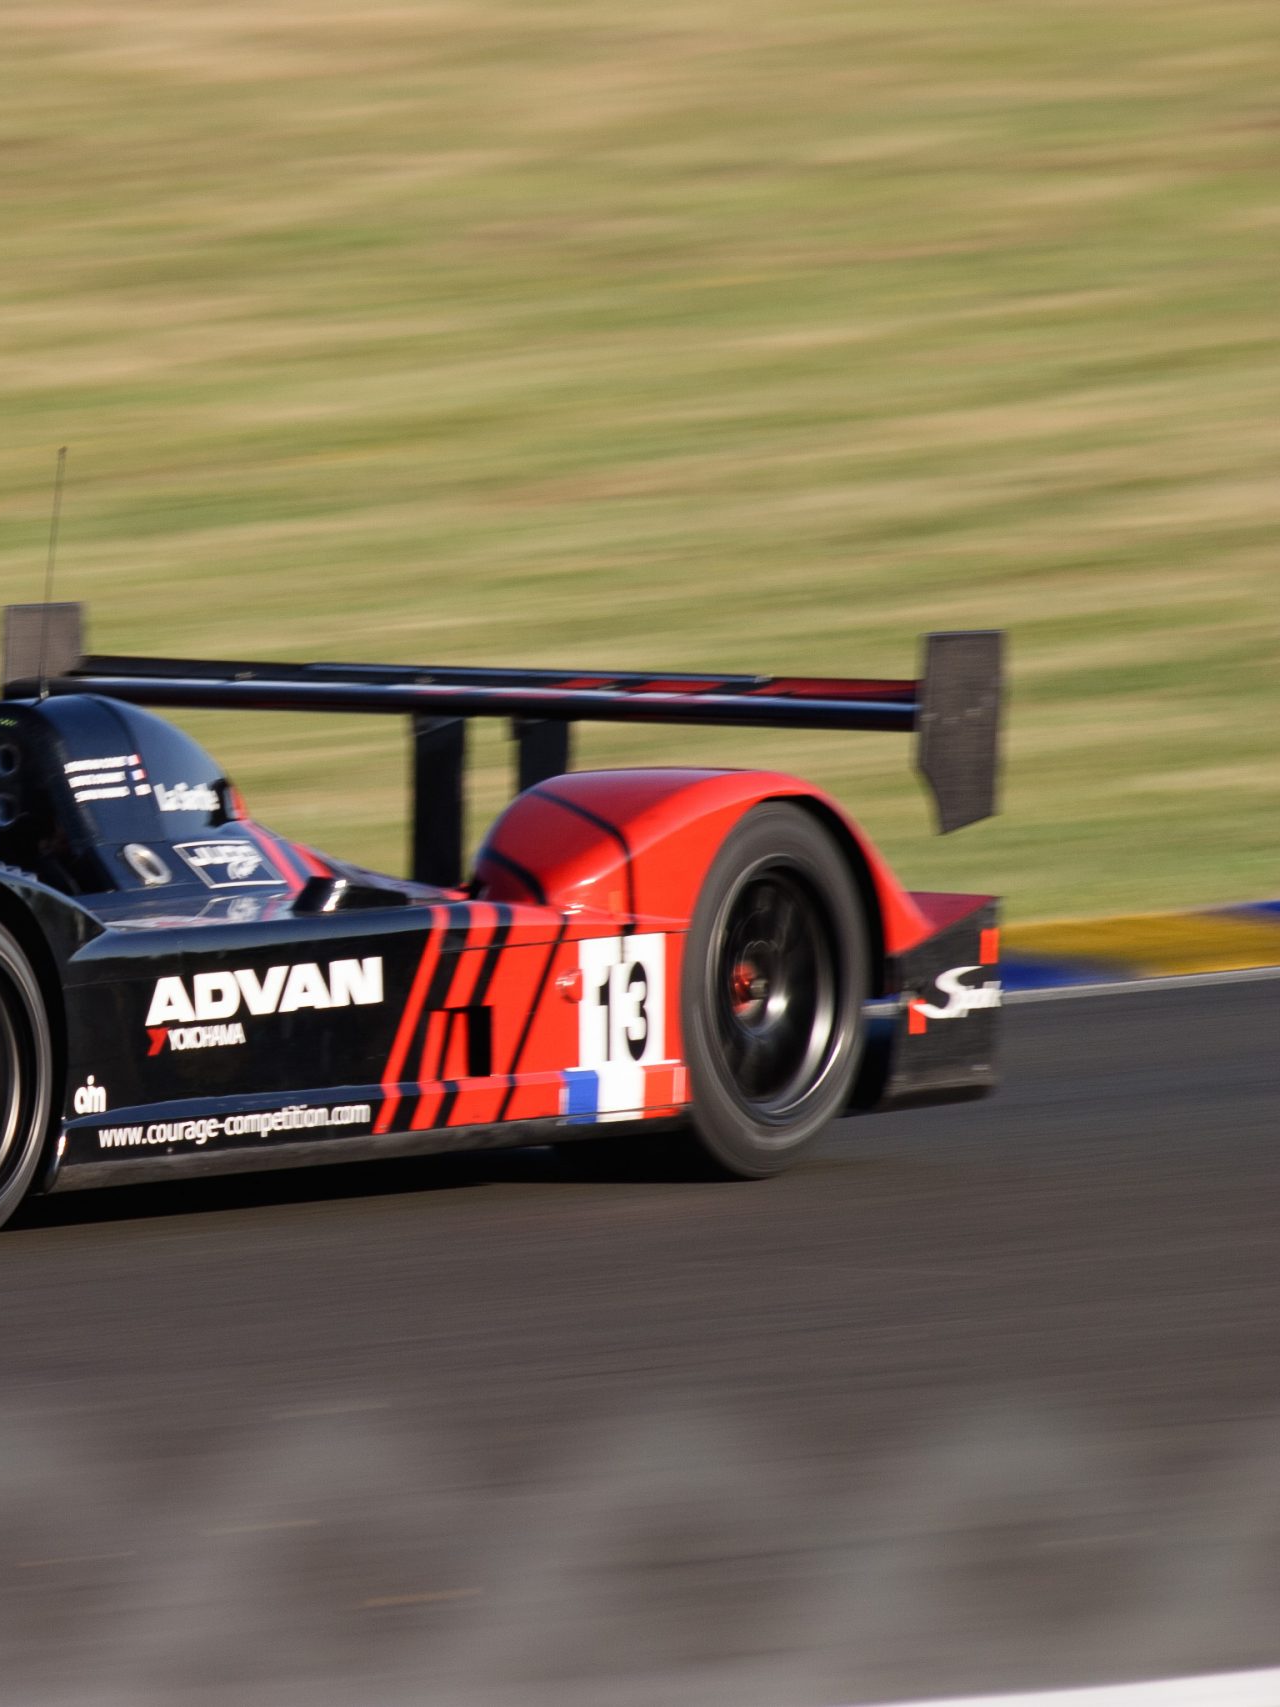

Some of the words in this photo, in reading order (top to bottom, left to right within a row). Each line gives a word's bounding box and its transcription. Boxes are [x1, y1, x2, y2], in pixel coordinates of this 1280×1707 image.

[144, 956, 383, 1026] ADVAN
[596, 961, 649, 1062] 13
[167, 1022, 246, 1051] YOKOHAMA
[98, 1103, 371, 1149] www.courage-competition.com
